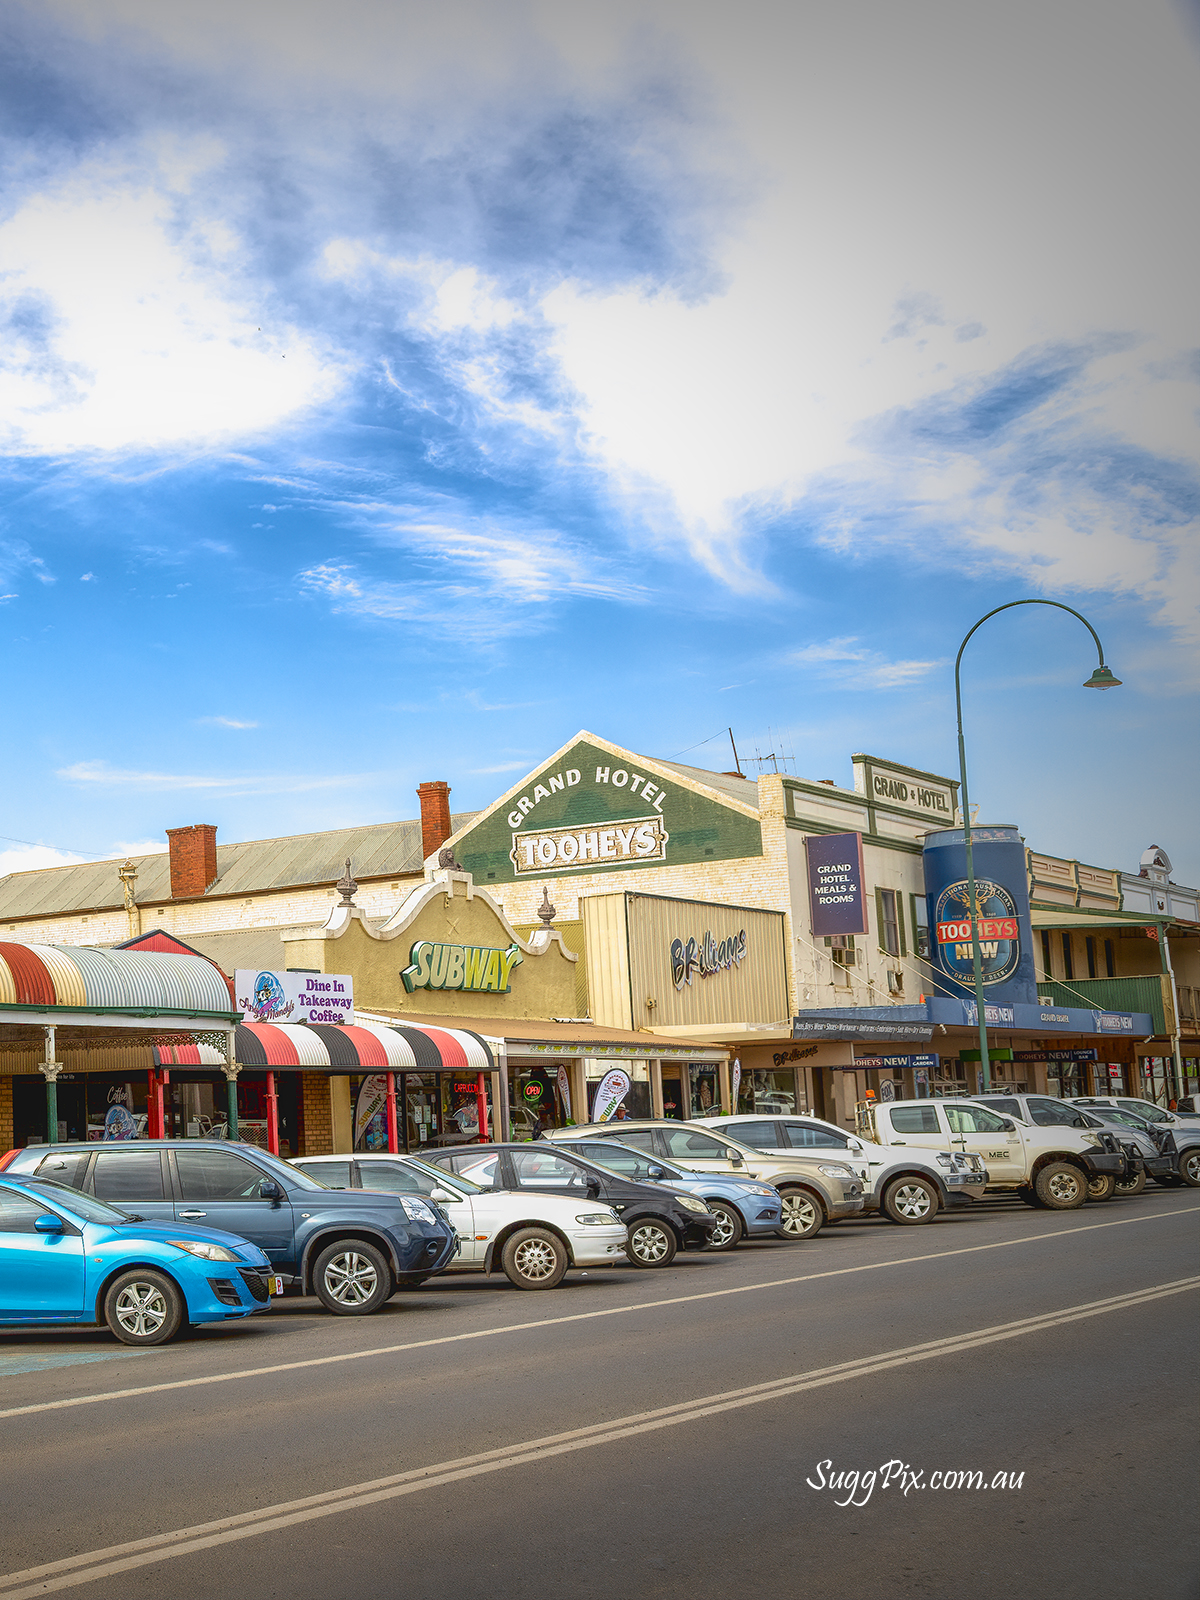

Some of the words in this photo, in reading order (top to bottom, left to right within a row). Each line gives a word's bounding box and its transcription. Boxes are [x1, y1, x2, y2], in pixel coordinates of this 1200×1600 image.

[507, 768, 583, 829] GRAND
[595, 766, 668, 813] HOTEL
[874, 775, 908, 802] GRAND
[917, 787, 950, 813] HOTEL
[521, 822, 657, 866] TOOHEYS
[817, 864, 852, 874] GRAND
[820, 874, 851, 884] HOTEL
[815, 885, 847, 894] MEALS
[849, 884, 857, 892] &
[819, 895, 855, 905] ROOMS
[402, 941, 522, 994] SUBWAY
[954, 972, 985, 982] DRAUGT
[306, 979, 331, 992] Dine
[333, 980, 345, 992] In
[298, 994, 352, 1010] Takeaway
[309, 1009, 344, 1022] Coffee
[999, 1008, 1014, 1022] NEW
[1120, 1016, 1133, 1029] NEW
[855, 1058, 881, 1066] OHEYS
[883, 1057, 908, 1066] NEW
[1049, 1052, 1070, 1060] NEW
[453, 1083, 479, 1092] CAPPUCCIN
[525, 1086, 541, 1095] OPEN
[107, 1086, 129, 1104] Coffee
[359, 1093, 382, 1128] SUBWAY
[599, 1096, 617, 1122] BWAY
